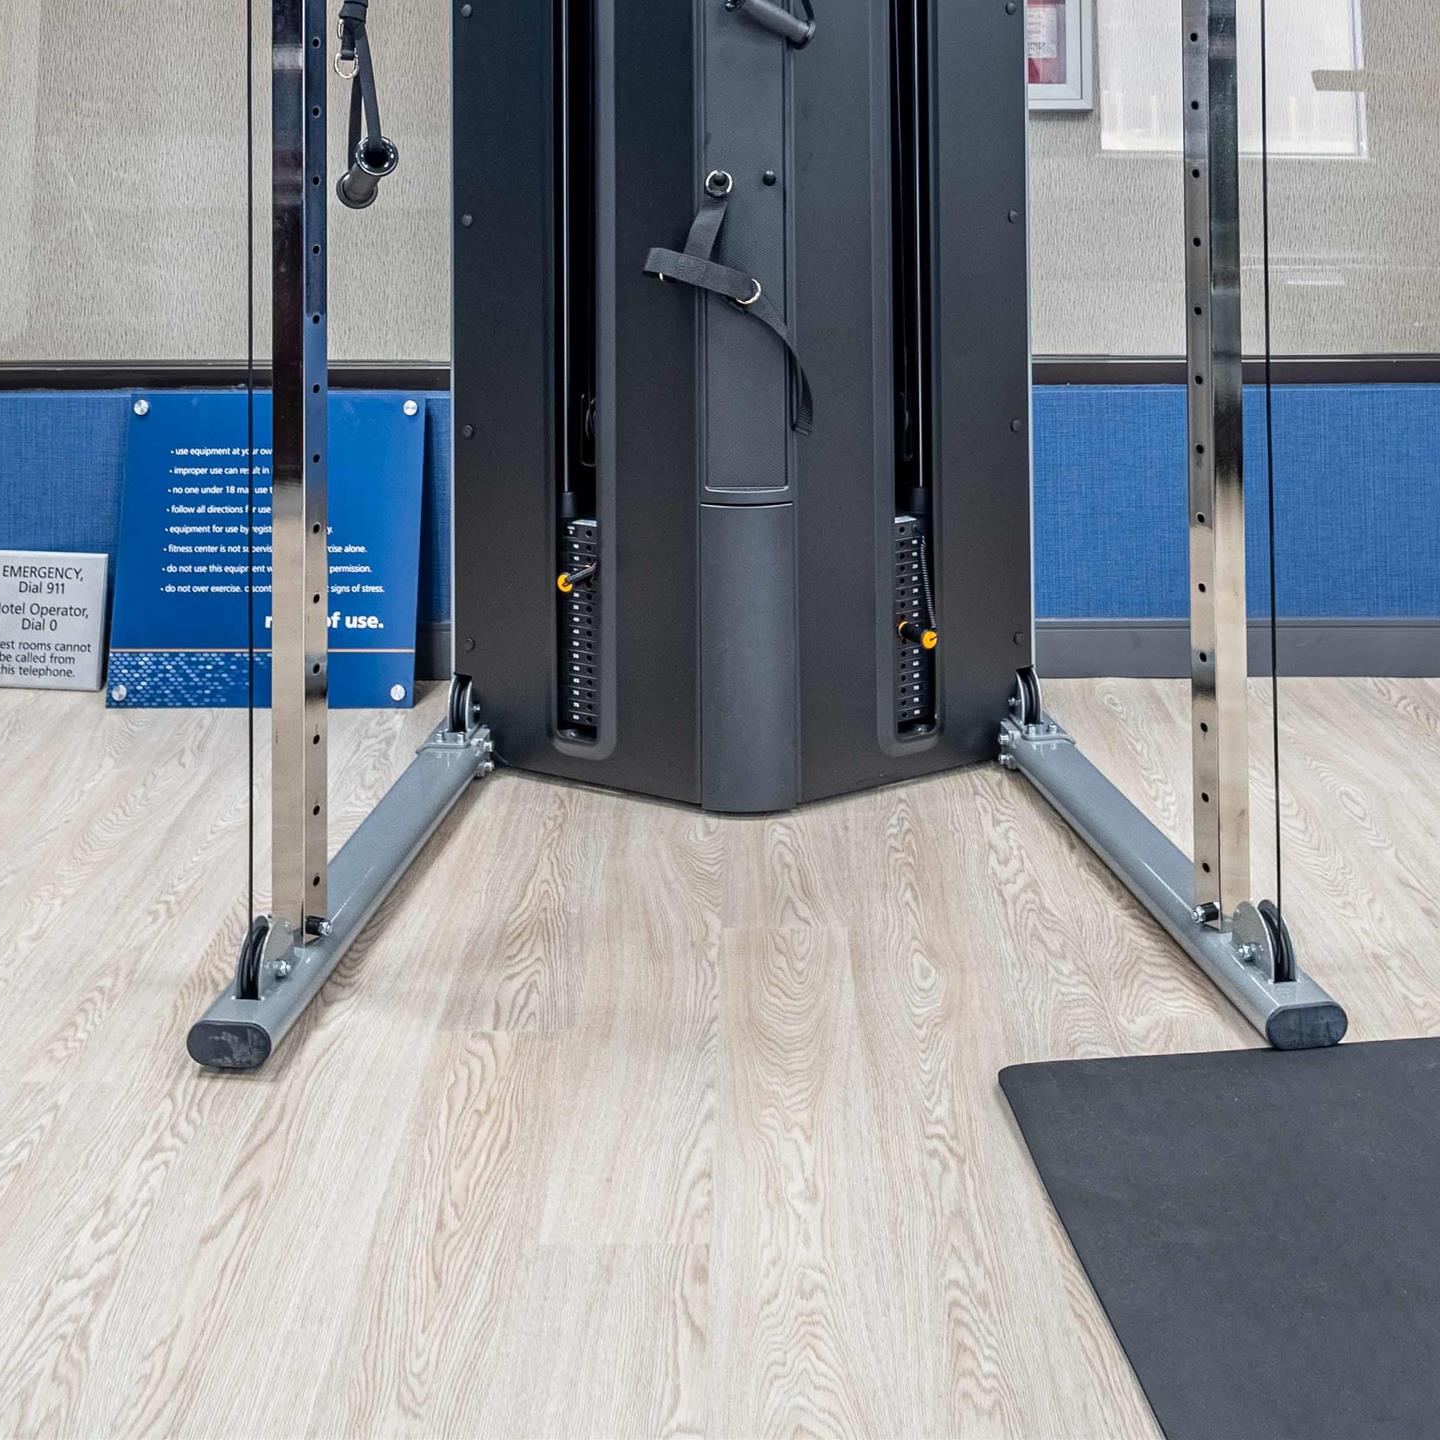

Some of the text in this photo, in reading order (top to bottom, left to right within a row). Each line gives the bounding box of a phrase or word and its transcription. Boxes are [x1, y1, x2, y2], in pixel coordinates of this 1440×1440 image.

[190, 447, 231, 456] equipment
[173, 466, 208, 476] improper
[262, 466, 269, 474] in
[201, 485, 223, 494] under
[226, 485, 235, 494] 18
[171, 505, 195, 514] follow
[196, 505, 206, 514] all
[207, 505, 243, 514] directions
[245, 505, 256, 514] fr
[169, 525, 211, 534] equipment
[212, 524, 223, 533] for
[240, 525, 249, 535] by
[252, 525, 272, 535] regist
[168, 544, 193, 553] fitness
[193, 545, 218, 553] center
[219, 544, 226, 553] is
[227, 545, 241, 553] not
[242, 544, 273, 553] supervis
[344, 543, 367, 553] alone.
[2, 565, 84, 582] EMERGENCY,
[166, 564, 177, 573] do
[178, 565, 192, 573] not
[208, 564, 223, 573] this
[329, 564, 372, 575] permission.
[19, 581, 65, 595] Dial 911
[165, 584, 176, 593] do
[177, 585, 191, 593] not
[210, 584, 242, 593] exercise.
[330, 583, 350, 595] signs
[351, 583, 360, 592] of
[361, 584, 385, 593] stress.
[29, 602, 89, 619] Operator,
[21, 618, 58, 632] Dial 0
[345, 615, 384, 629] use.
[18, 642, 52, 652] rooms
[54, 643, 91, 653] cannot
[0, 651, 76, 664] be called from
[18, 665, 76, 678] telephone.
